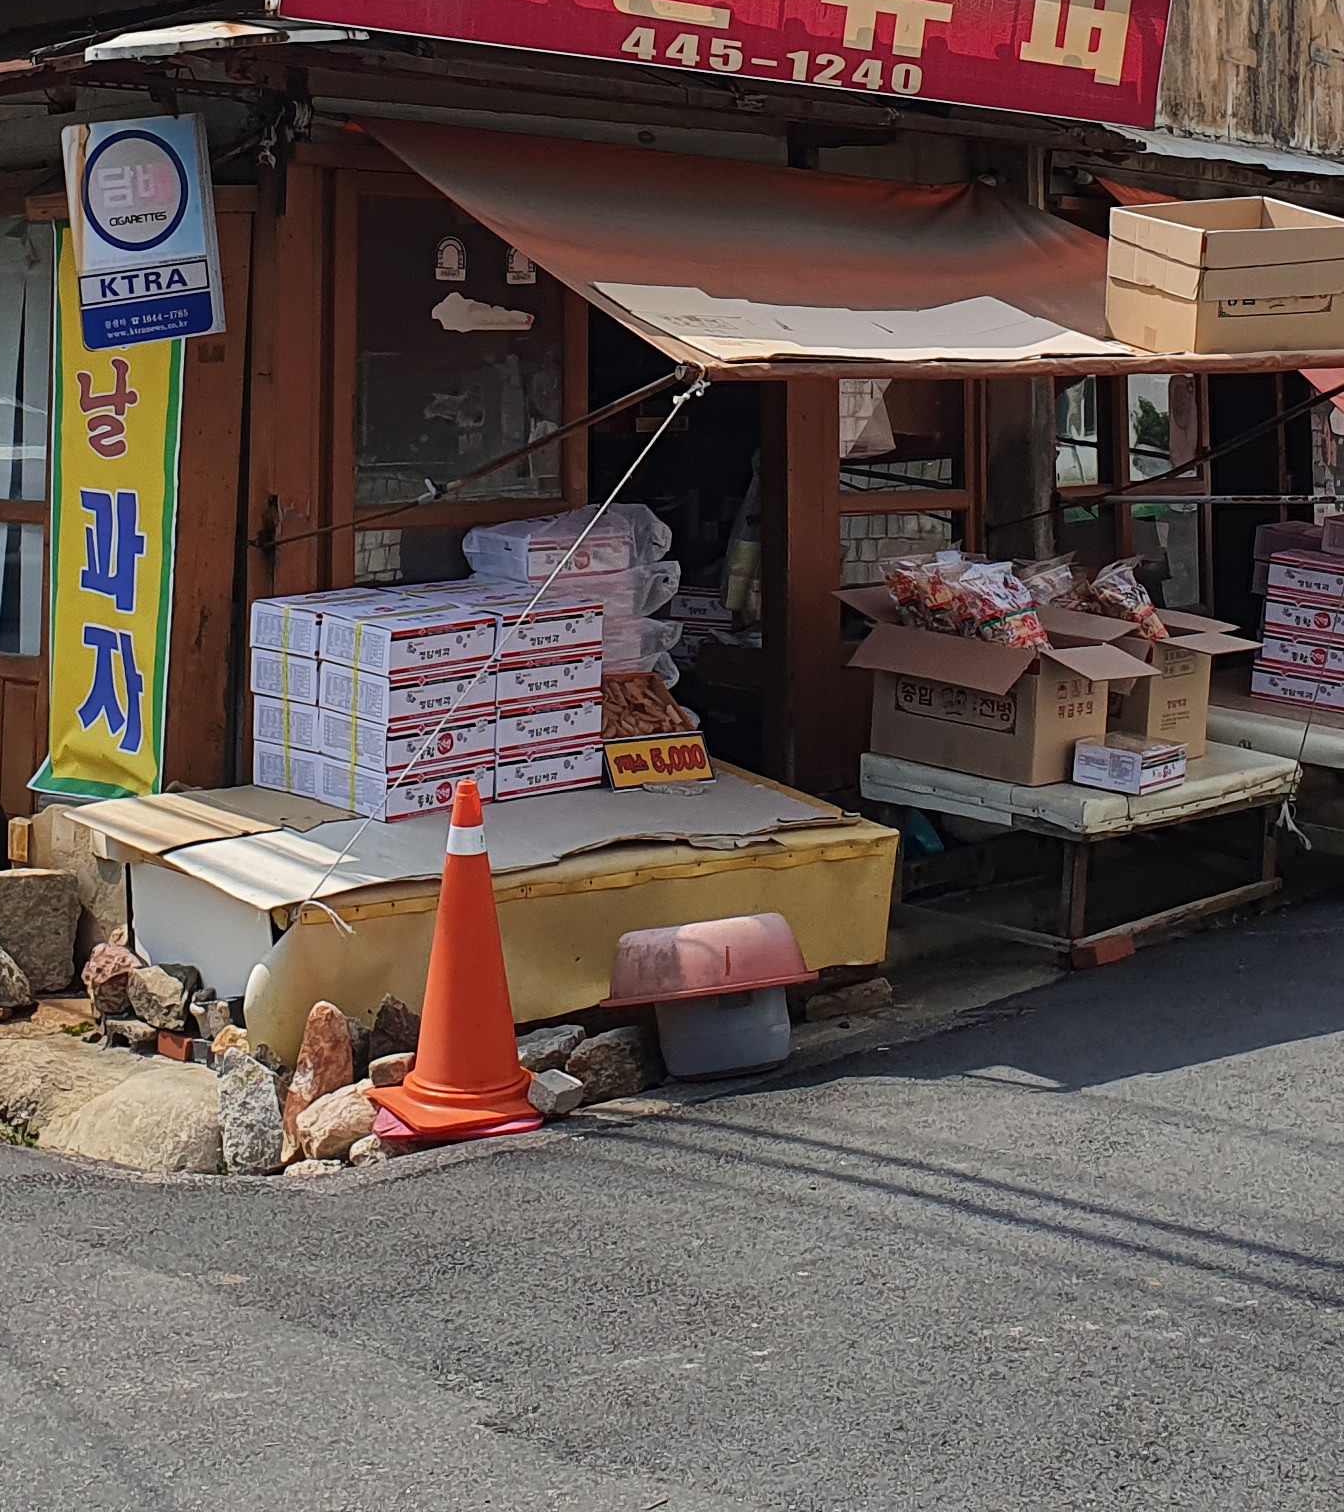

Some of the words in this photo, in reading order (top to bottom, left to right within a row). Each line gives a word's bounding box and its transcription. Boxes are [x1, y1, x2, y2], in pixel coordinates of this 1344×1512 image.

[620, 26, 923, 96] 445-1240
[96, 163, 174, 208] 담배
[109, 211, 167, 227] CIGARETTES
[99, 268, 188, 299] KTRA
[76, 345, 140, 459] 날
[77, 489, 147, 754] 과자
[901, 681, 933, 707] 종합
[979, 695, 1012, 723] 전병
[650, 743, 707, 776] 5,000
